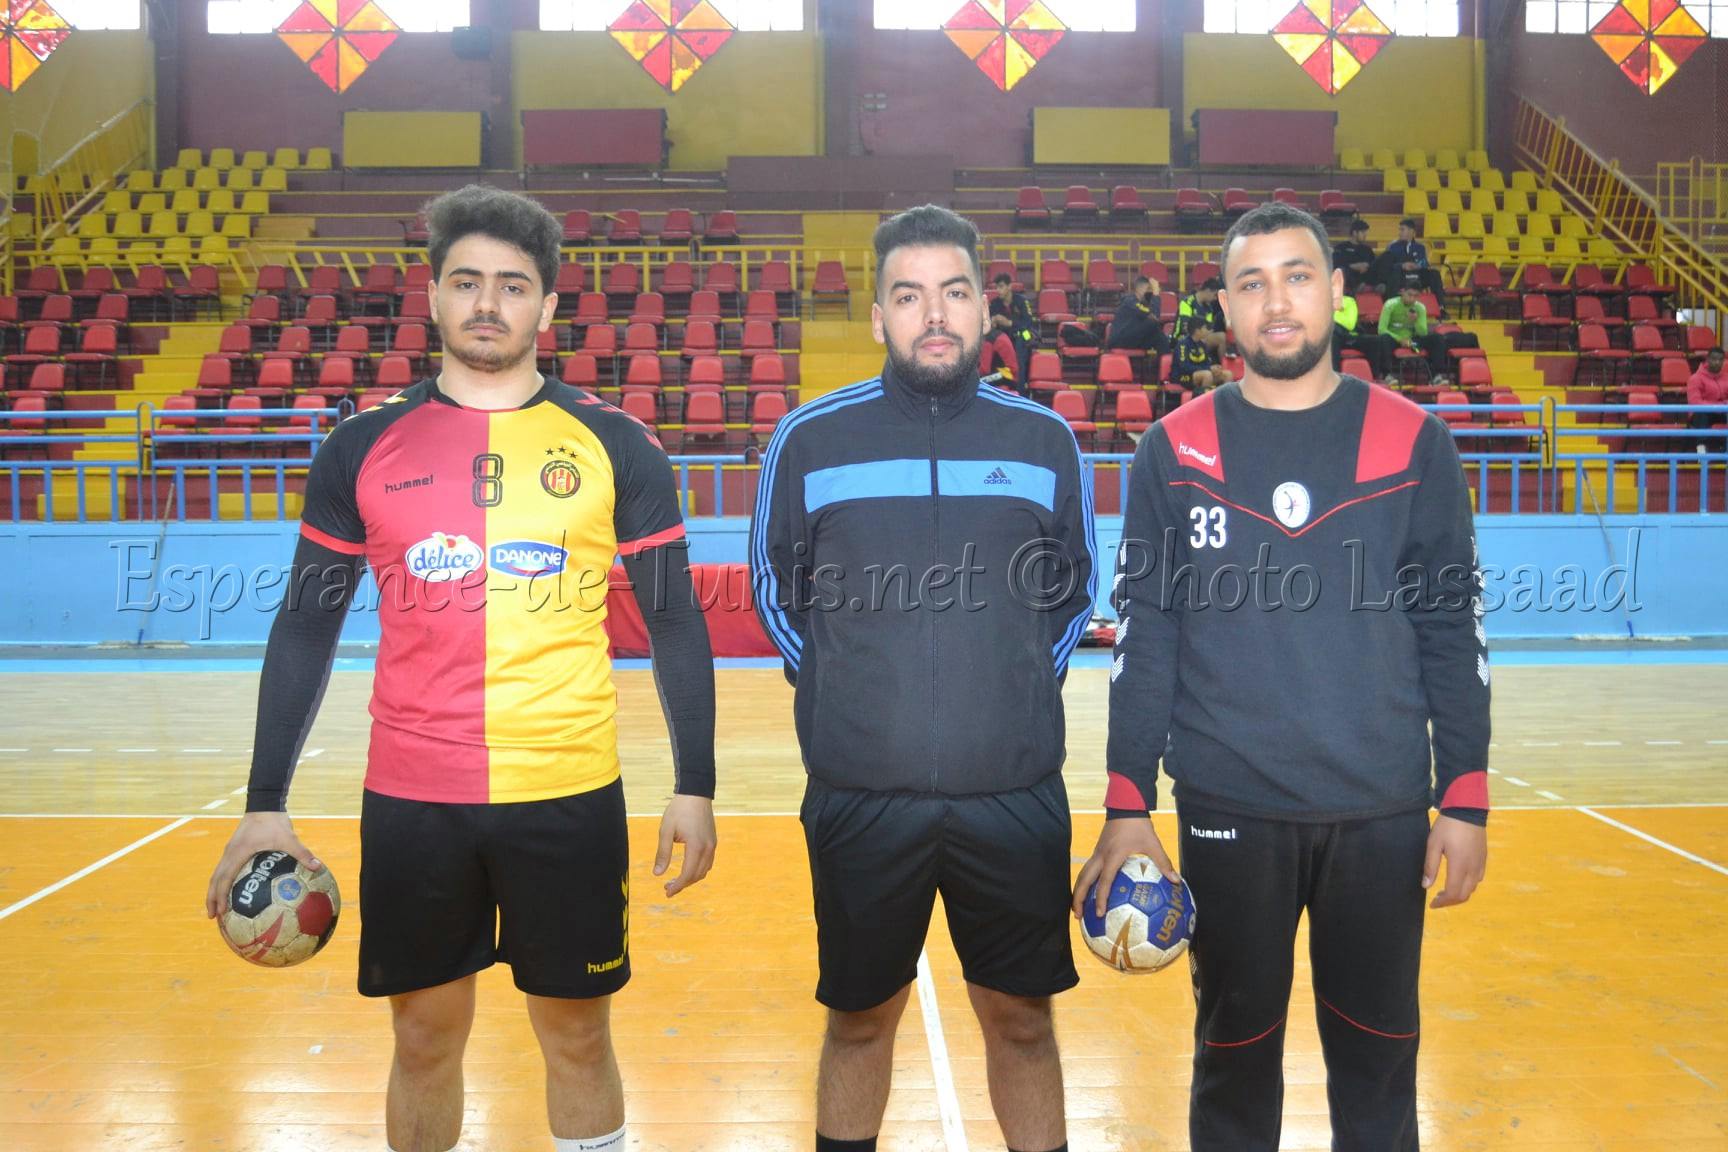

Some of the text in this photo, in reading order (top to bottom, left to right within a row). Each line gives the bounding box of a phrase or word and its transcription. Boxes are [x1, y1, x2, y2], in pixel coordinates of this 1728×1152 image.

[1179, 442, 1216, 466] hummel
[385, 474, 434, 494] hummel
[472, 453, 504, 508] 8
[1189, 505, 1226, 549] 33
[1190, 825, 1236, 839] hummel
